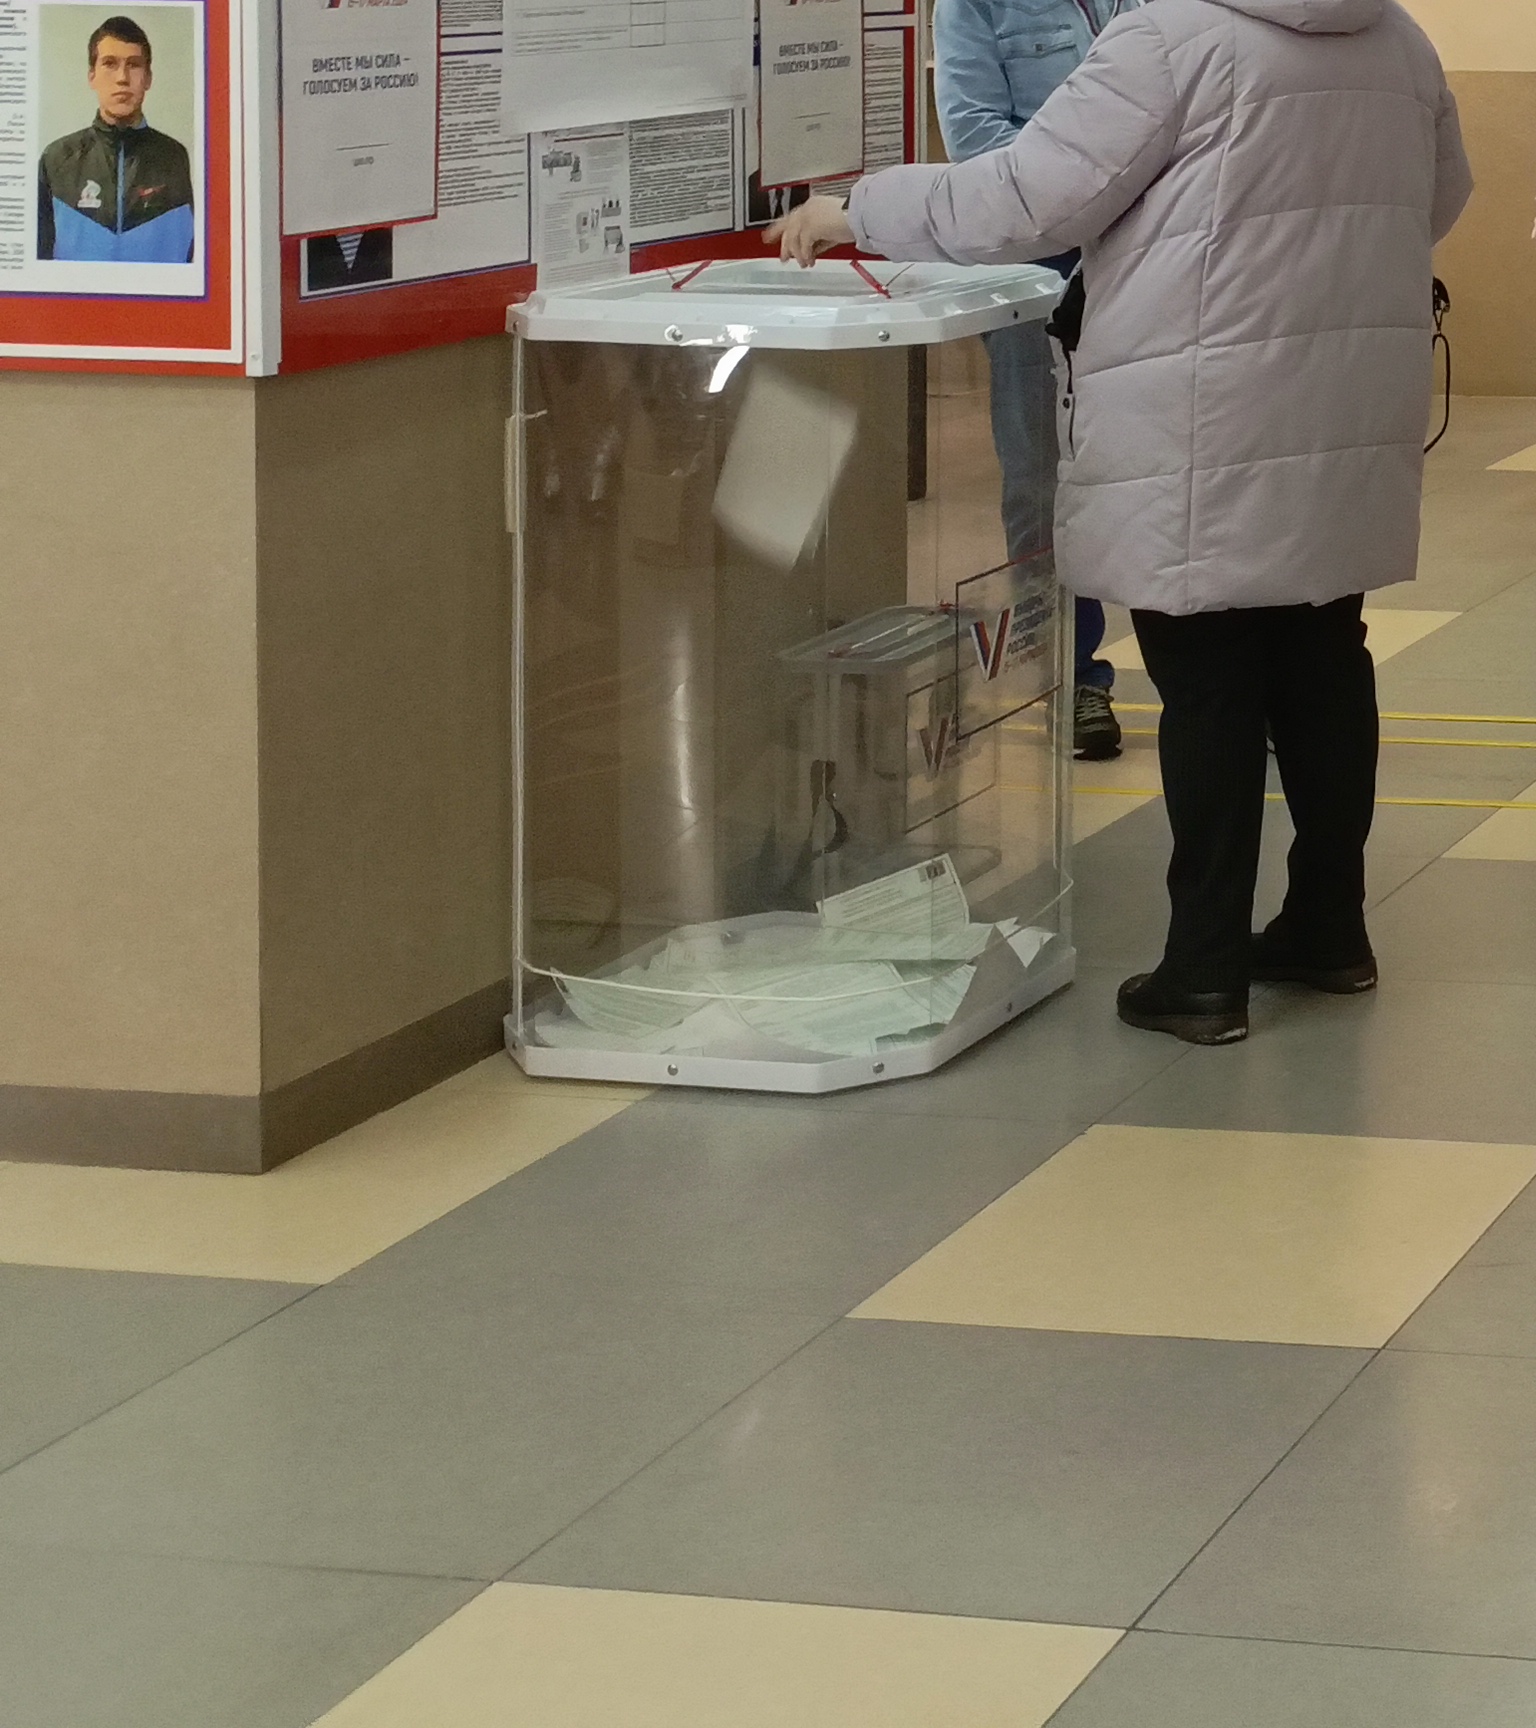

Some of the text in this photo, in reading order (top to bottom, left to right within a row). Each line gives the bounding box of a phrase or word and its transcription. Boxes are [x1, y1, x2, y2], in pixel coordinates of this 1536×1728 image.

[312, 56, 352, 73] ВМЕСТЕ
[355, 55, 373, 70] МЫ
[375, 53, 401, 68] СИЛА
[303, 77, 357, 95] ГОЛОСУЕМ
[360, 75, 372, 91] ЗА
